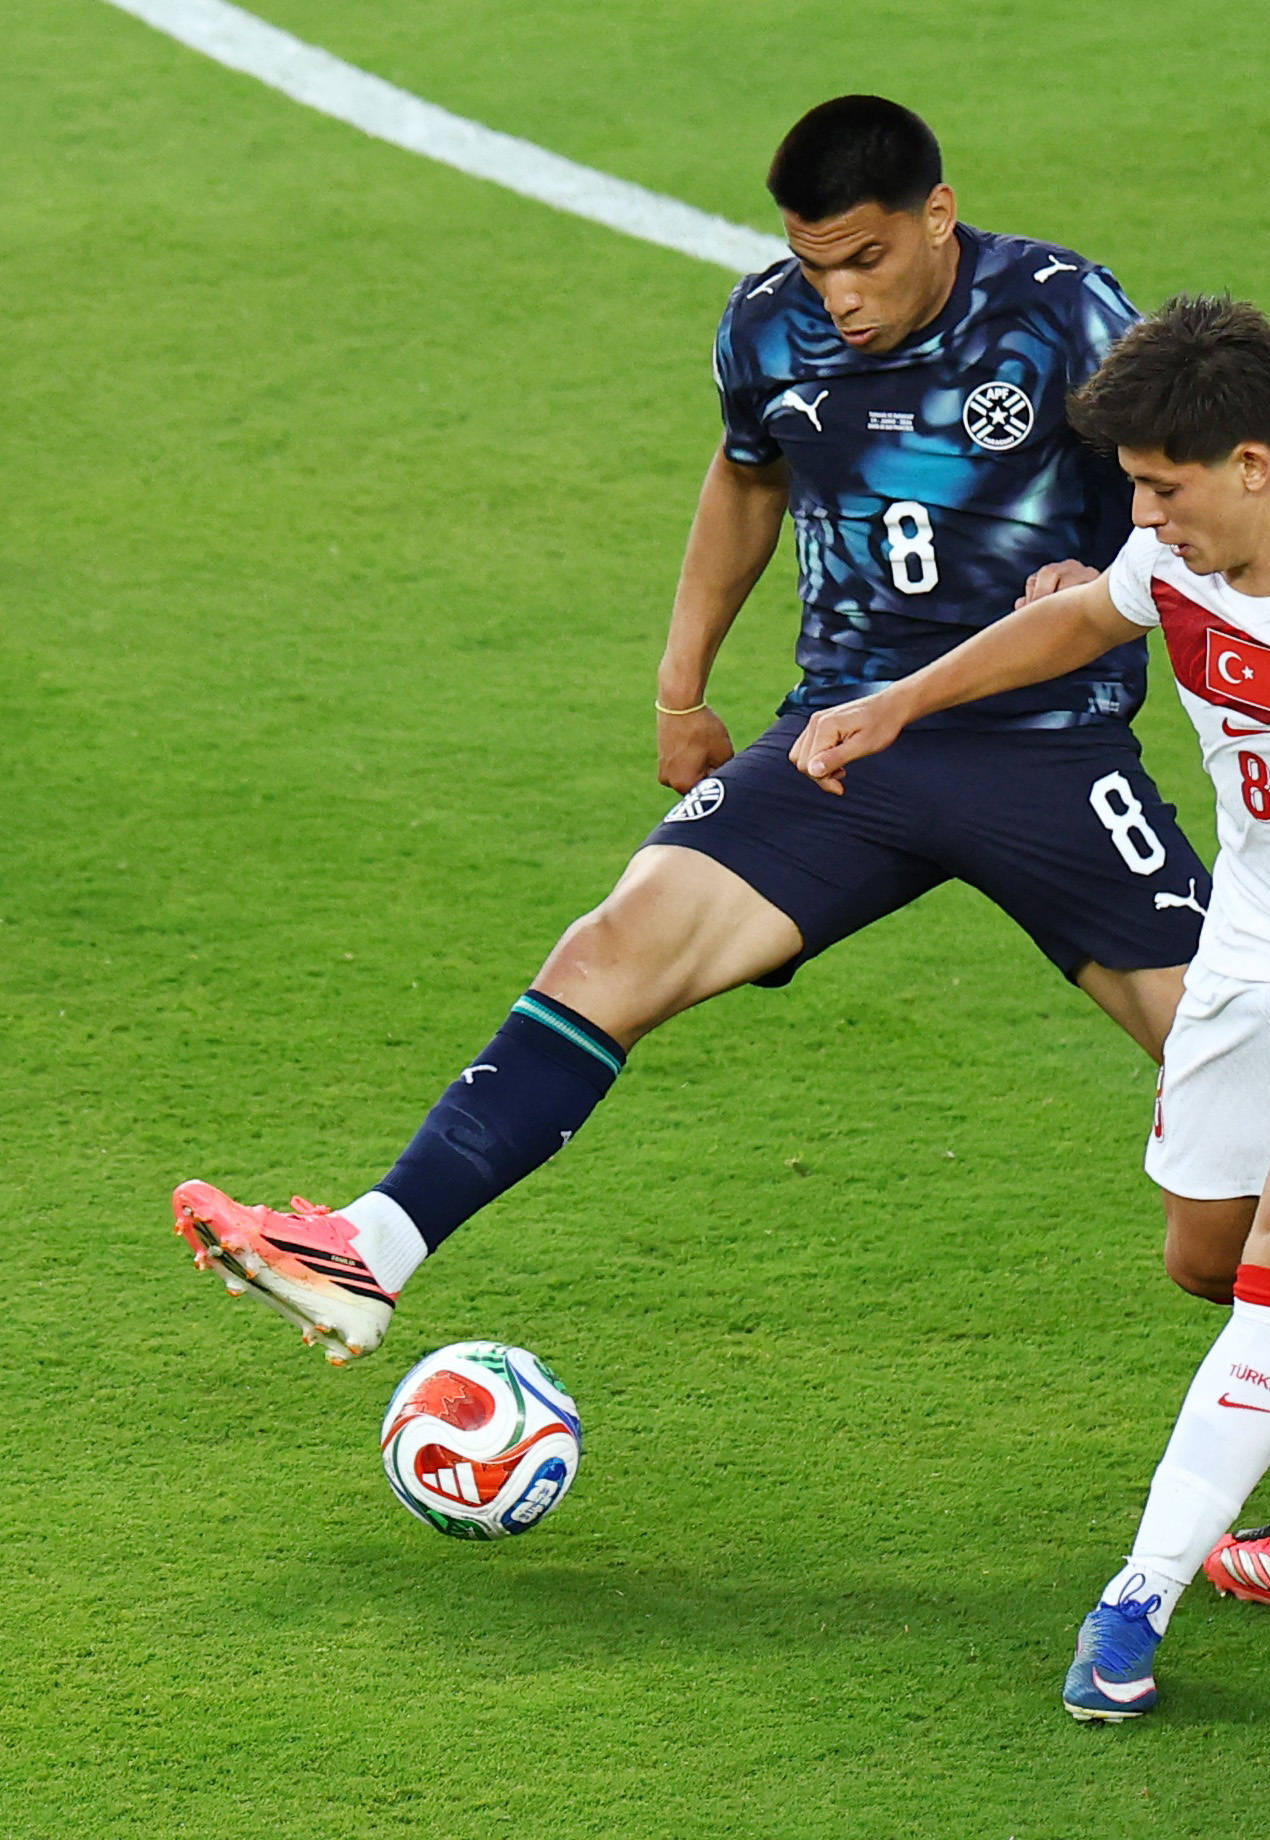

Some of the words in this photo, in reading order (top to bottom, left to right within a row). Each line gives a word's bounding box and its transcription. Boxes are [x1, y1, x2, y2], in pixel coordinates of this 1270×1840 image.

[986, 387, 1009, 400] APF
[883, 501, 938, 594] 8
[1089, 769, 1166, 875] 8
